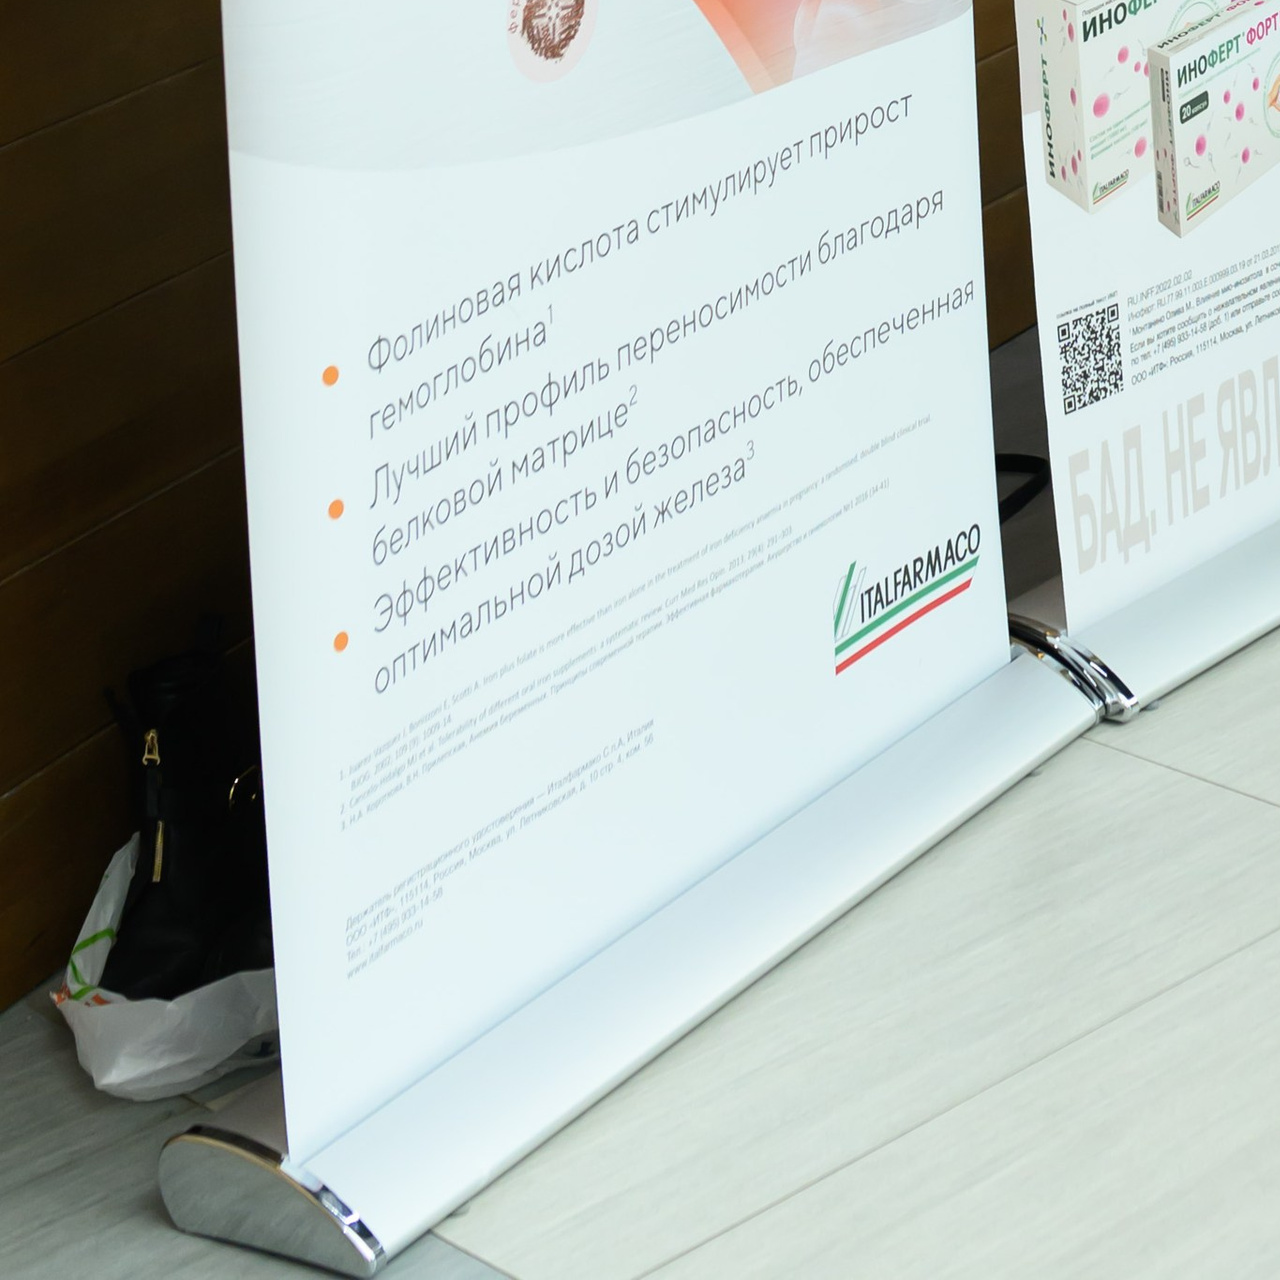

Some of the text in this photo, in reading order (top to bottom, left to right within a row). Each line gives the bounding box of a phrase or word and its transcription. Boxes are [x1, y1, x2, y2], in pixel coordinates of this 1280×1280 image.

[1040, 52, 1056, 180] ИНОФЕРТ
[1181, 105, 1192, 118] 20
[368, 94, 912, 374] Фолиновая кислота стимулирует прирост
[370, 190, 944, 510] Лучший профиль переносимости благодаря
[372, 458, 502, 566] белковой
[374, 279, 974, 633] Эффективность и безопасность, обеспеченная
[1068, 423, 1158, 576] БАД.
[1161, 392, 1211, 527] НЕ
[374, 552, 561, 695] оптимальной
[569, 502, 647, 585] дозой
[860, 522, 981, 625] ITALFARMACO
